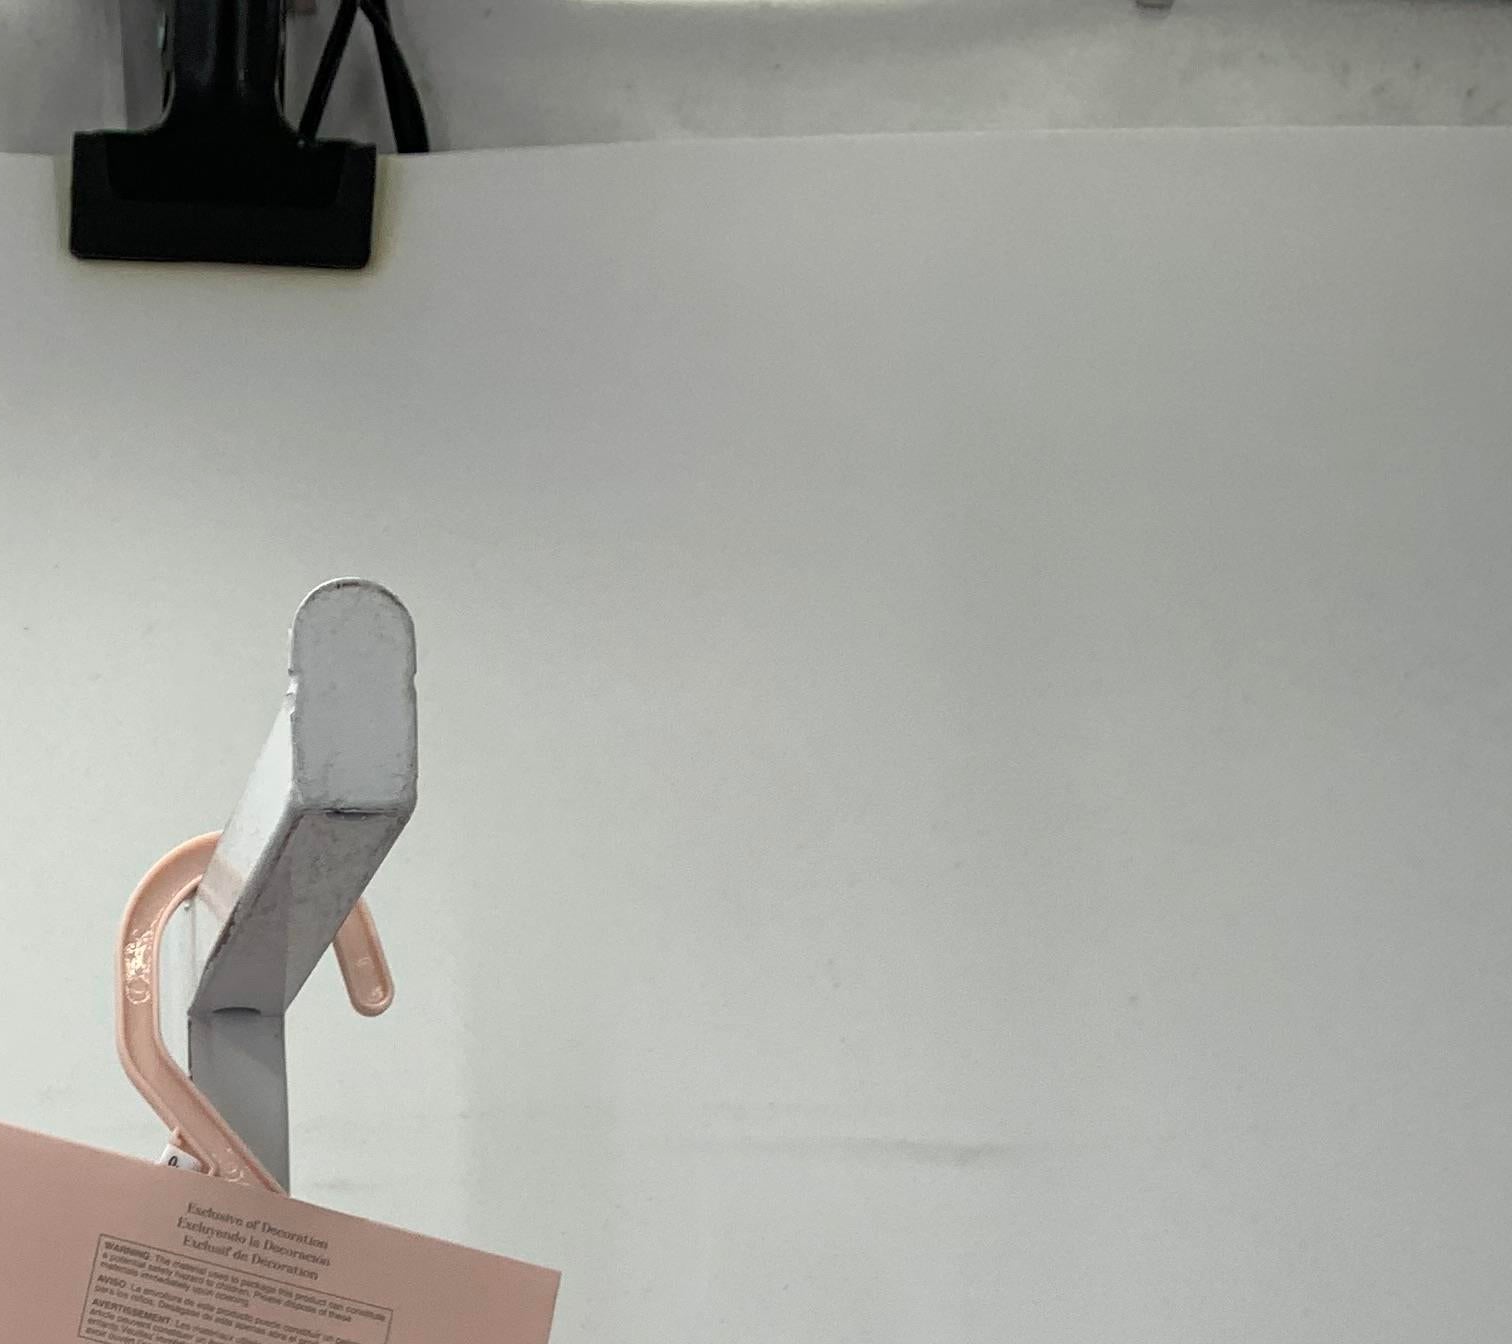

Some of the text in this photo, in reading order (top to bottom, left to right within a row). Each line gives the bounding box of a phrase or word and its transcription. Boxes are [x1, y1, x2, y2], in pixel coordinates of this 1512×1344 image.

[187, 1202, 328, 1250] Exclusive of Decoration
[233, 1250, 248, 1261] de
